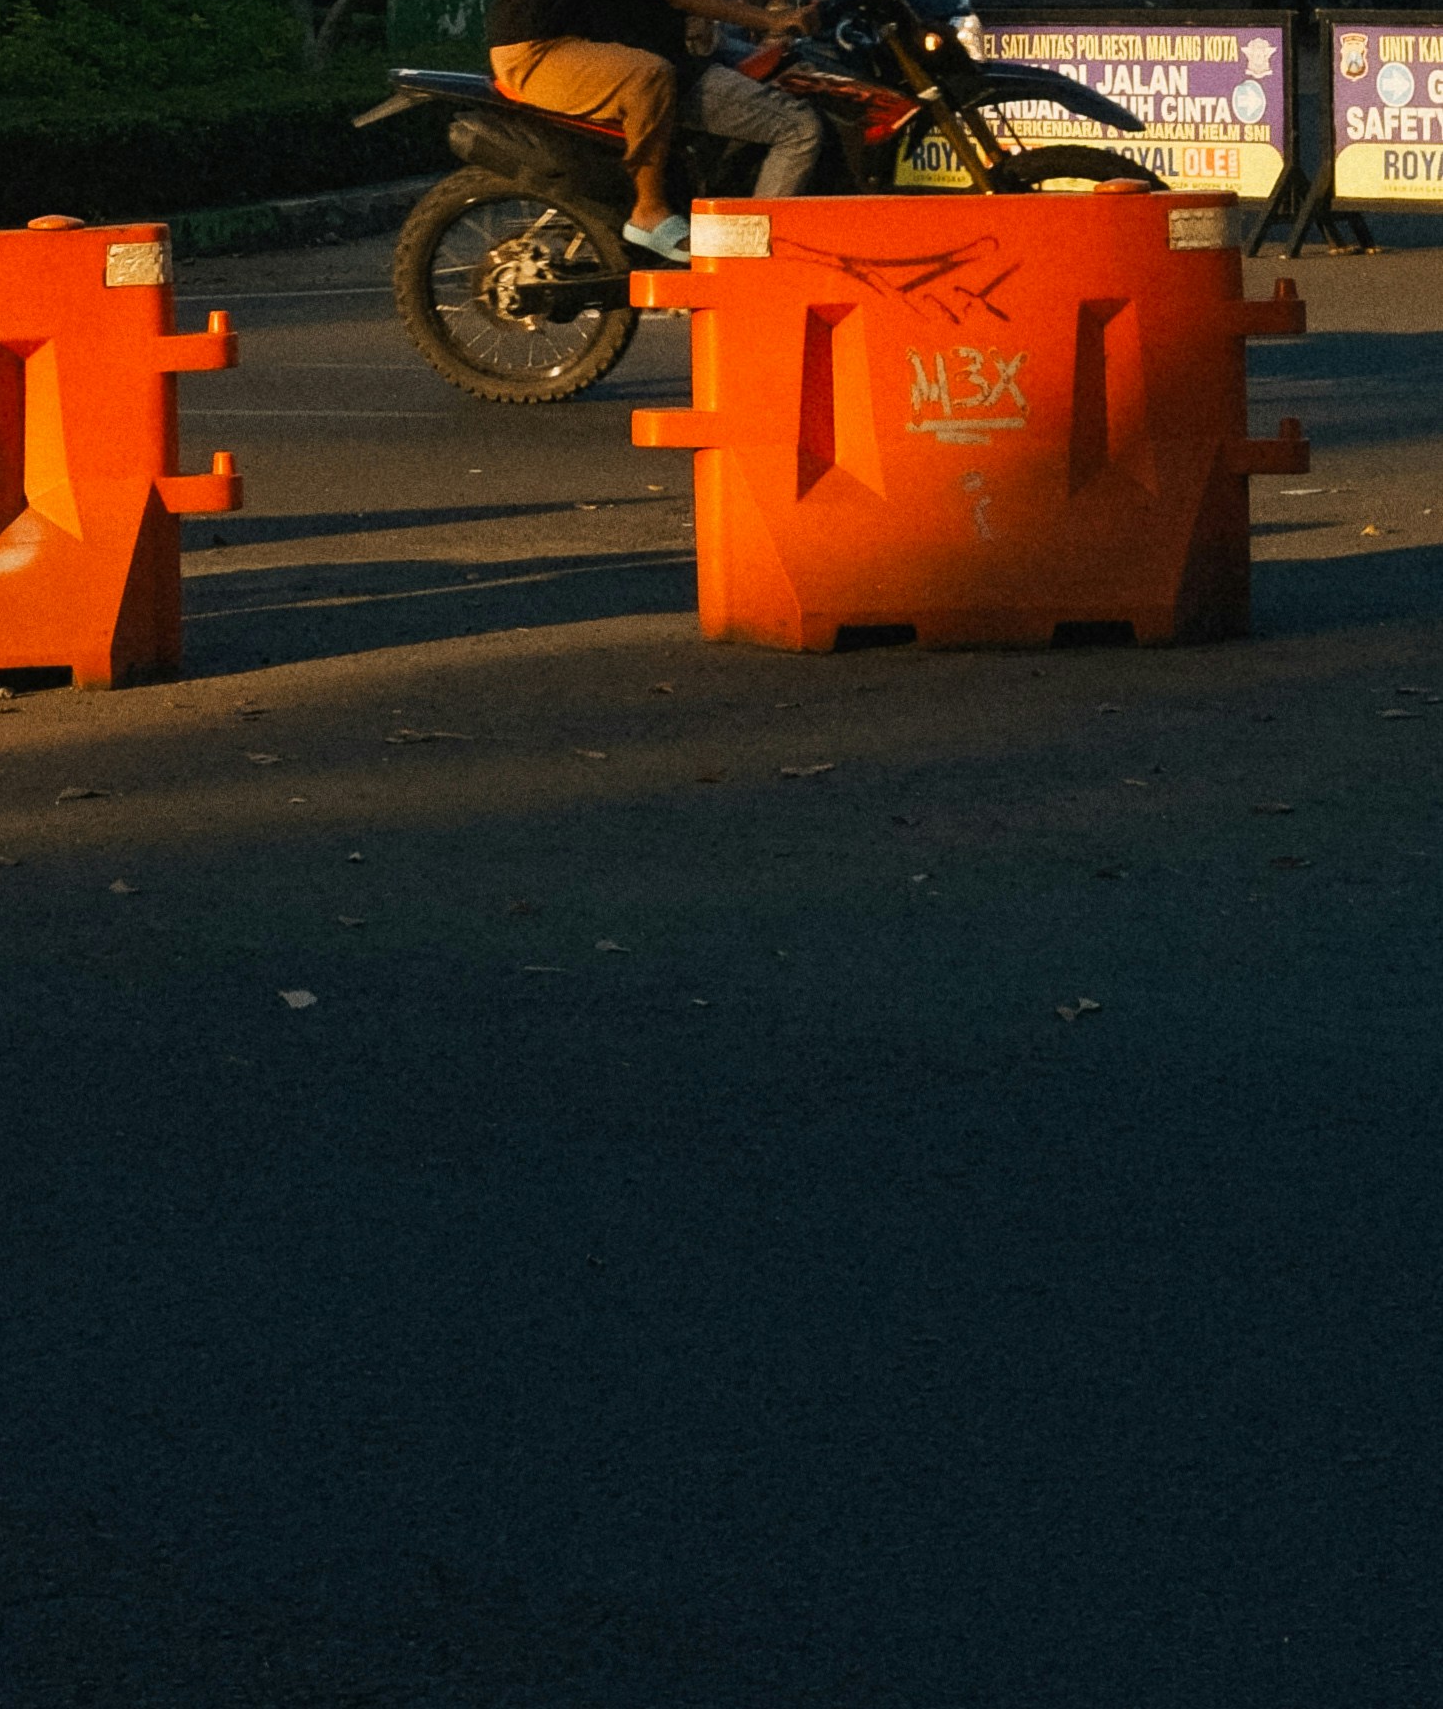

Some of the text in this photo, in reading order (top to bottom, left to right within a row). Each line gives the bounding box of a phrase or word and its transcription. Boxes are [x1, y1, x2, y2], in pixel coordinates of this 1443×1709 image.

[1000, 34, 1074, 61] SATLANTAS
[1076, 34, 1145, 61] POLRESTA
[1147, 35, 1201, 62] MALANG
[1204, 36, 1239, 63] KOTA
[1379, 35, 1443, 63] UNIT KA
[1096, 64, 1189, 96] JALAN
[978, 98, 1069, 120] EINDAH
[1160, 97, 1232, 124] CINTA
[1198, 124, 1240, 141] HELM
[1243, 124, 1271, 142] SNI
[912, 142, 967, 172] ROY
[1105, 146, 1180, 177] OYAL
[1183, 148, 1227, 178] OLE
